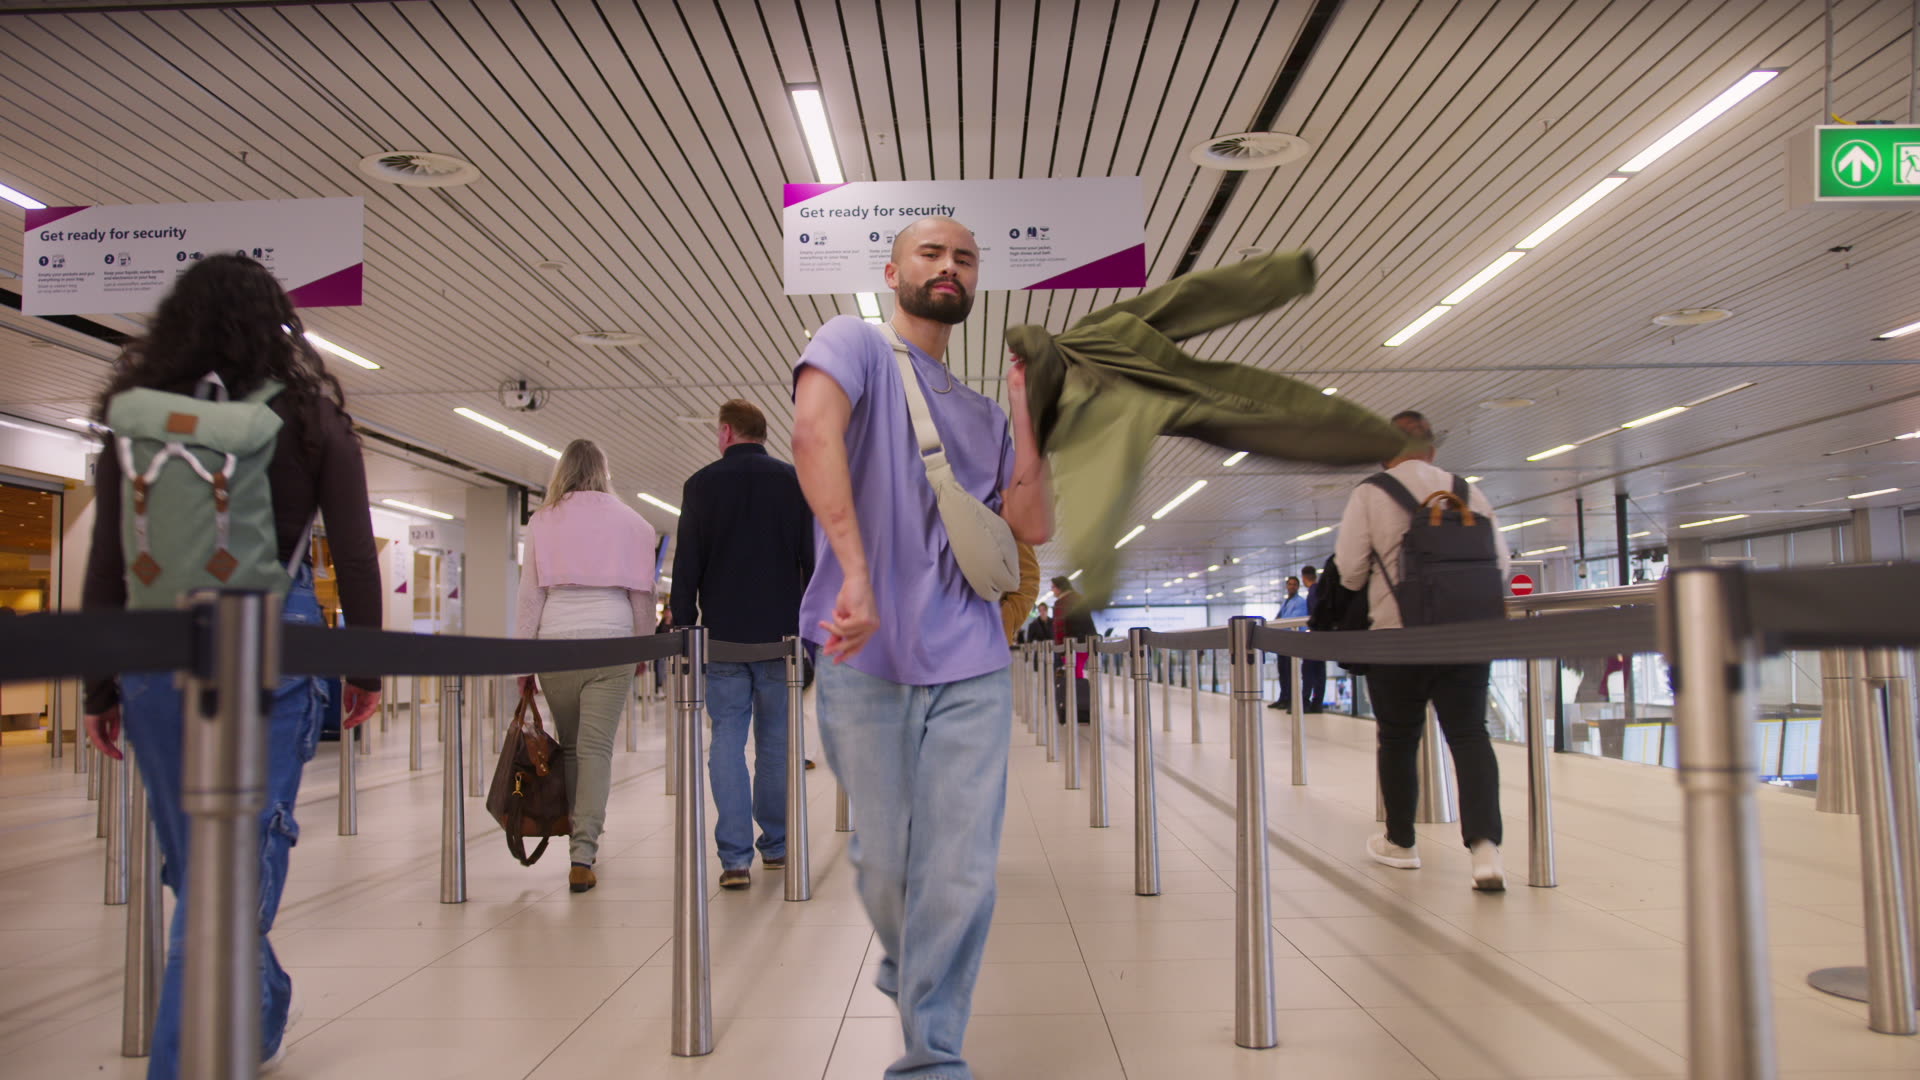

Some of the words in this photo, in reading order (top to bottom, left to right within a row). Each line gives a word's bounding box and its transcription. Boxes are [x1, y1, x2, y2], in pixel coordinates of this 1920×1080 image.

[799, 206, 825, 218] Get
[828, 205, 869, 220] ready
[873, 204, 894, 216] for
[898, 204, 956, 218] security
[40, 230, 64, 242] Get
[67, 228, 106, 243] ready
[109, 228, 130, 240] for
[132, 226, 188, 240] security
[411, 530, 435, 540] 12-13
